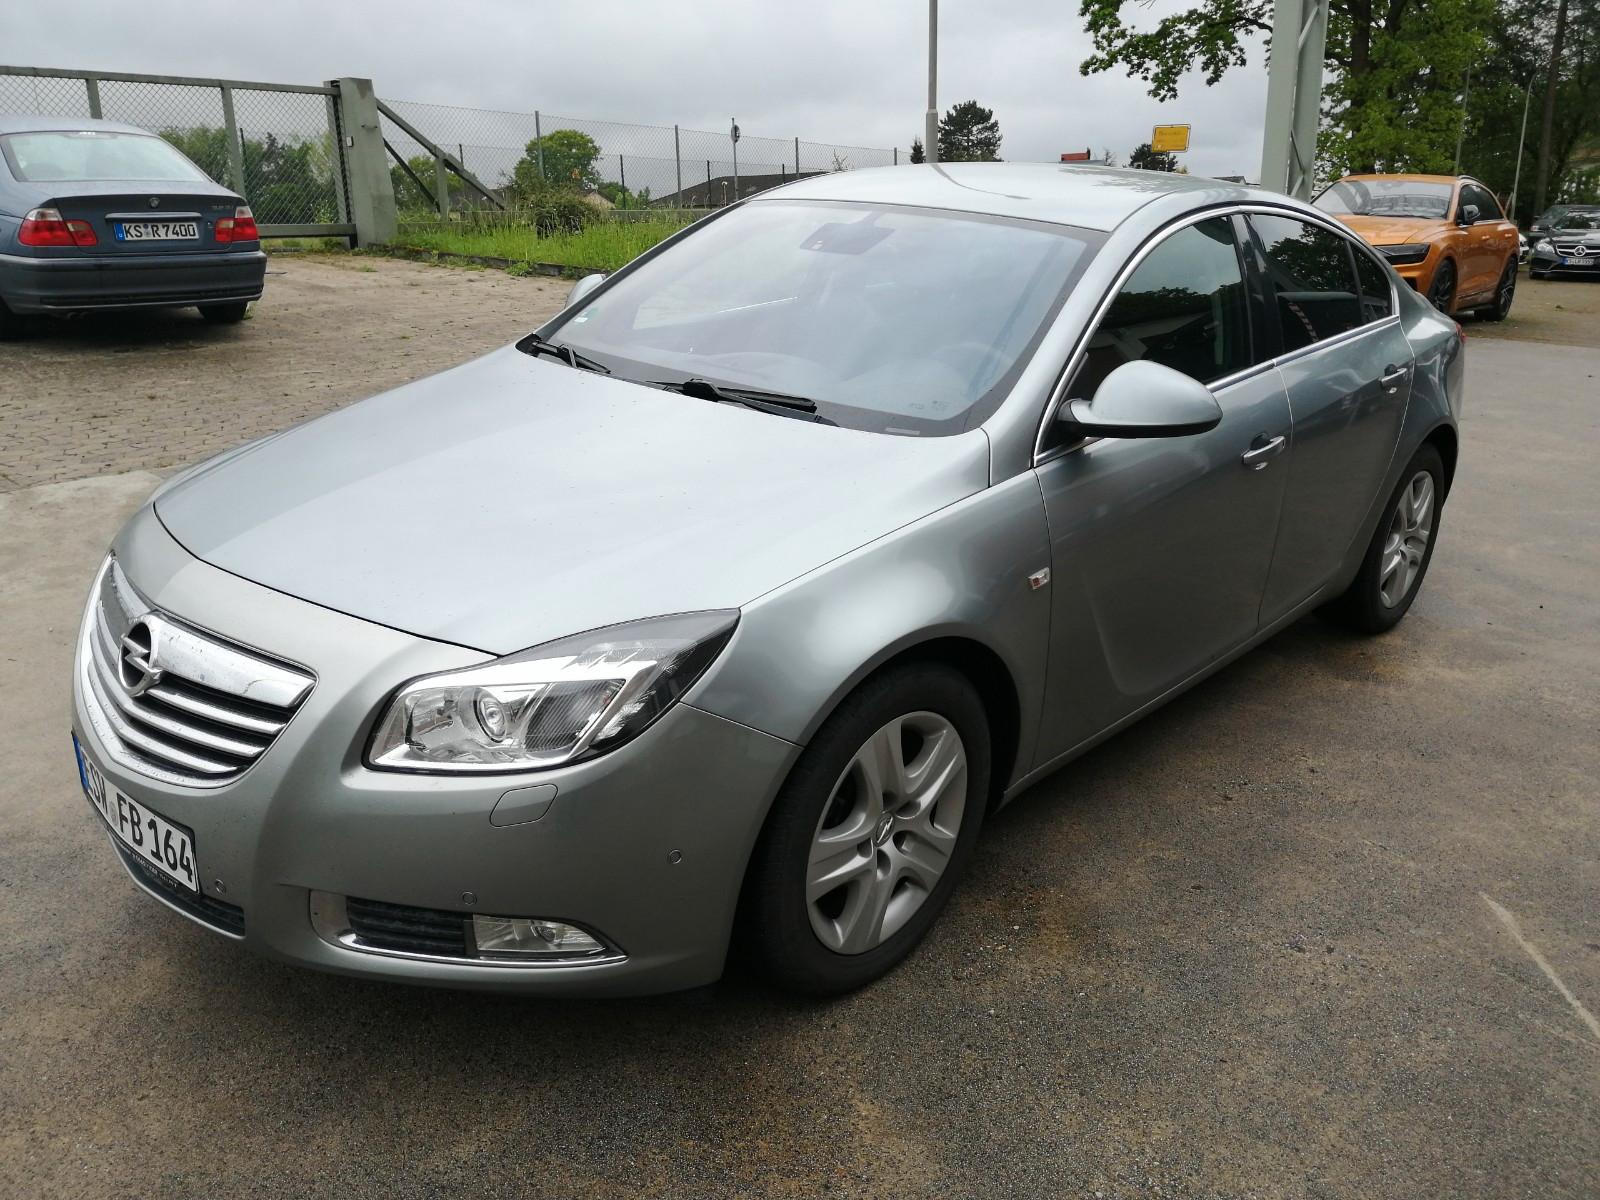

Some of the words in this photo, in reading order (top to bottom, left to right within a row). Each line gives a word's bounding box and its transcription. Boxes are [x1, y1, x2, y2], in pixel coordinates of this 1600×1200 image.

[124, 224, 143, 238] KS
[117, 792, 144, 847] FB
[148, 818, 193, 883] 164
